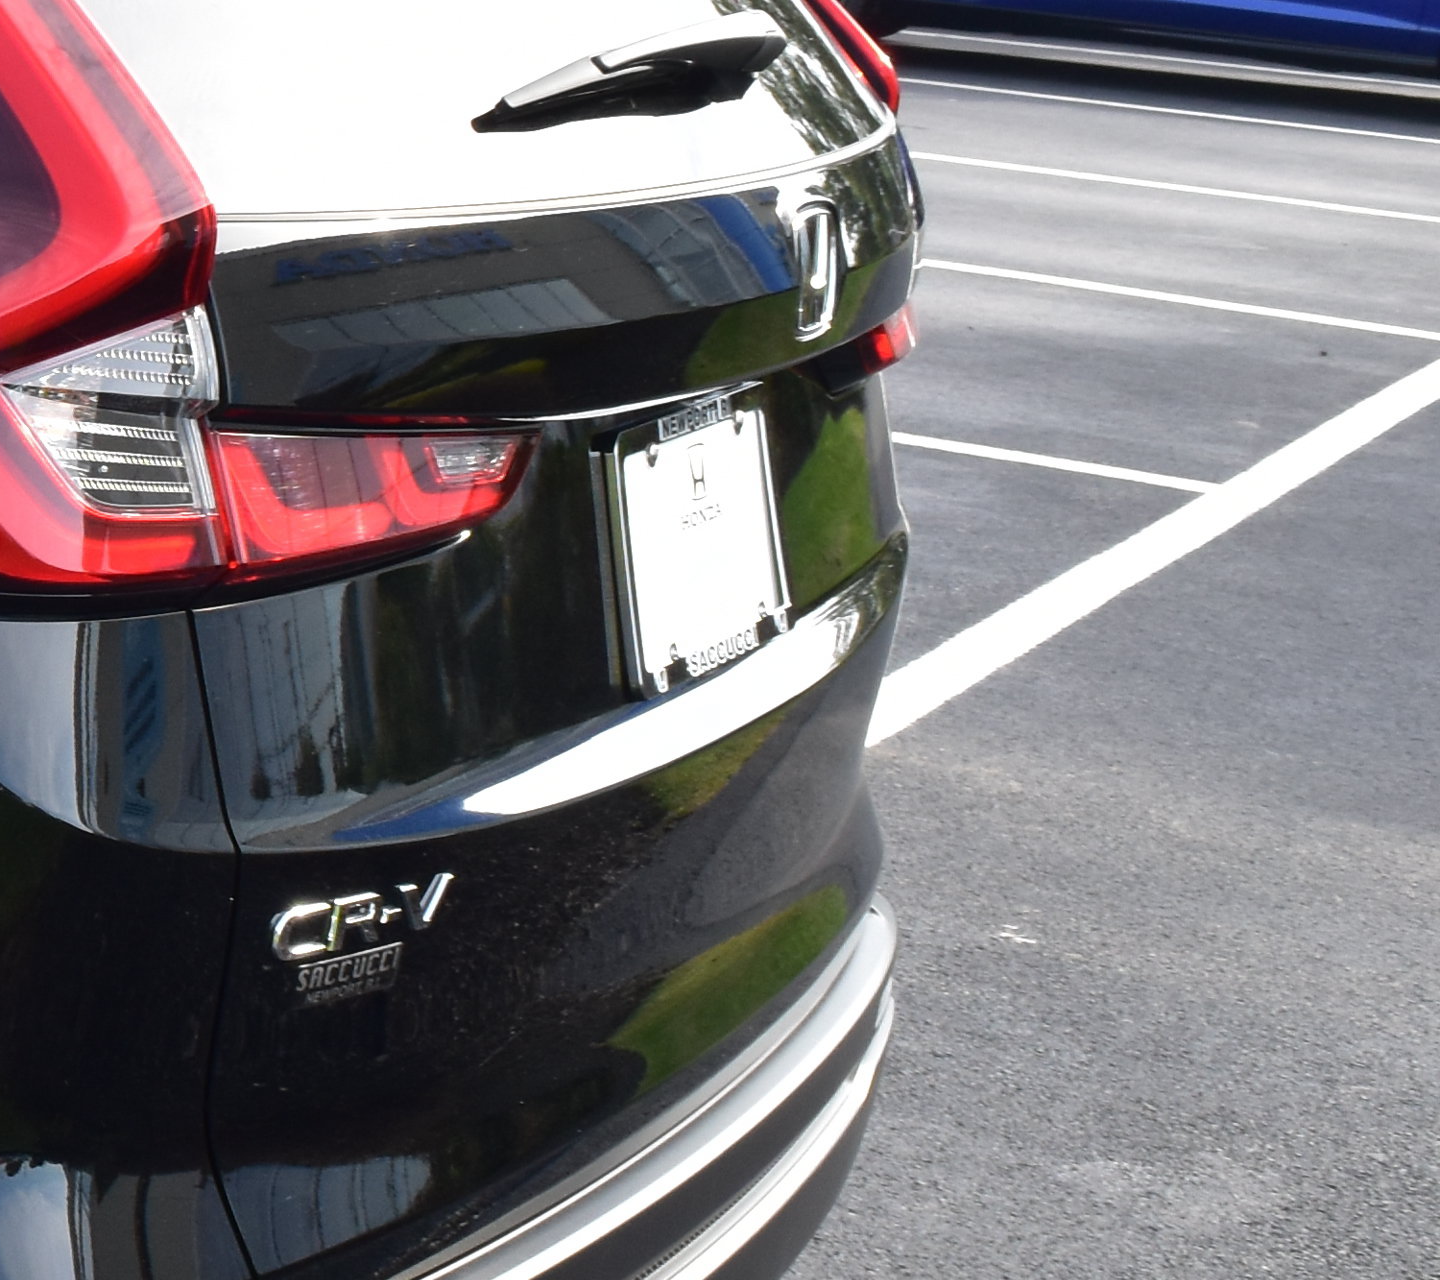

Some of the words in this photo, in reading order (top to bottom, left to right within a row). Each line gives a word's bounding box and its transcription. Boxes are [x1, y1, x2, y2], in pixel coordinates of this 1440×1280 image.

[659, 401, 716, 440] NEWPORT
[689, 626, 760, 675] SACCUCCI
[270, 872, 456, 962] CR-V
[296, 946, 400, 992] SACCUCCI
